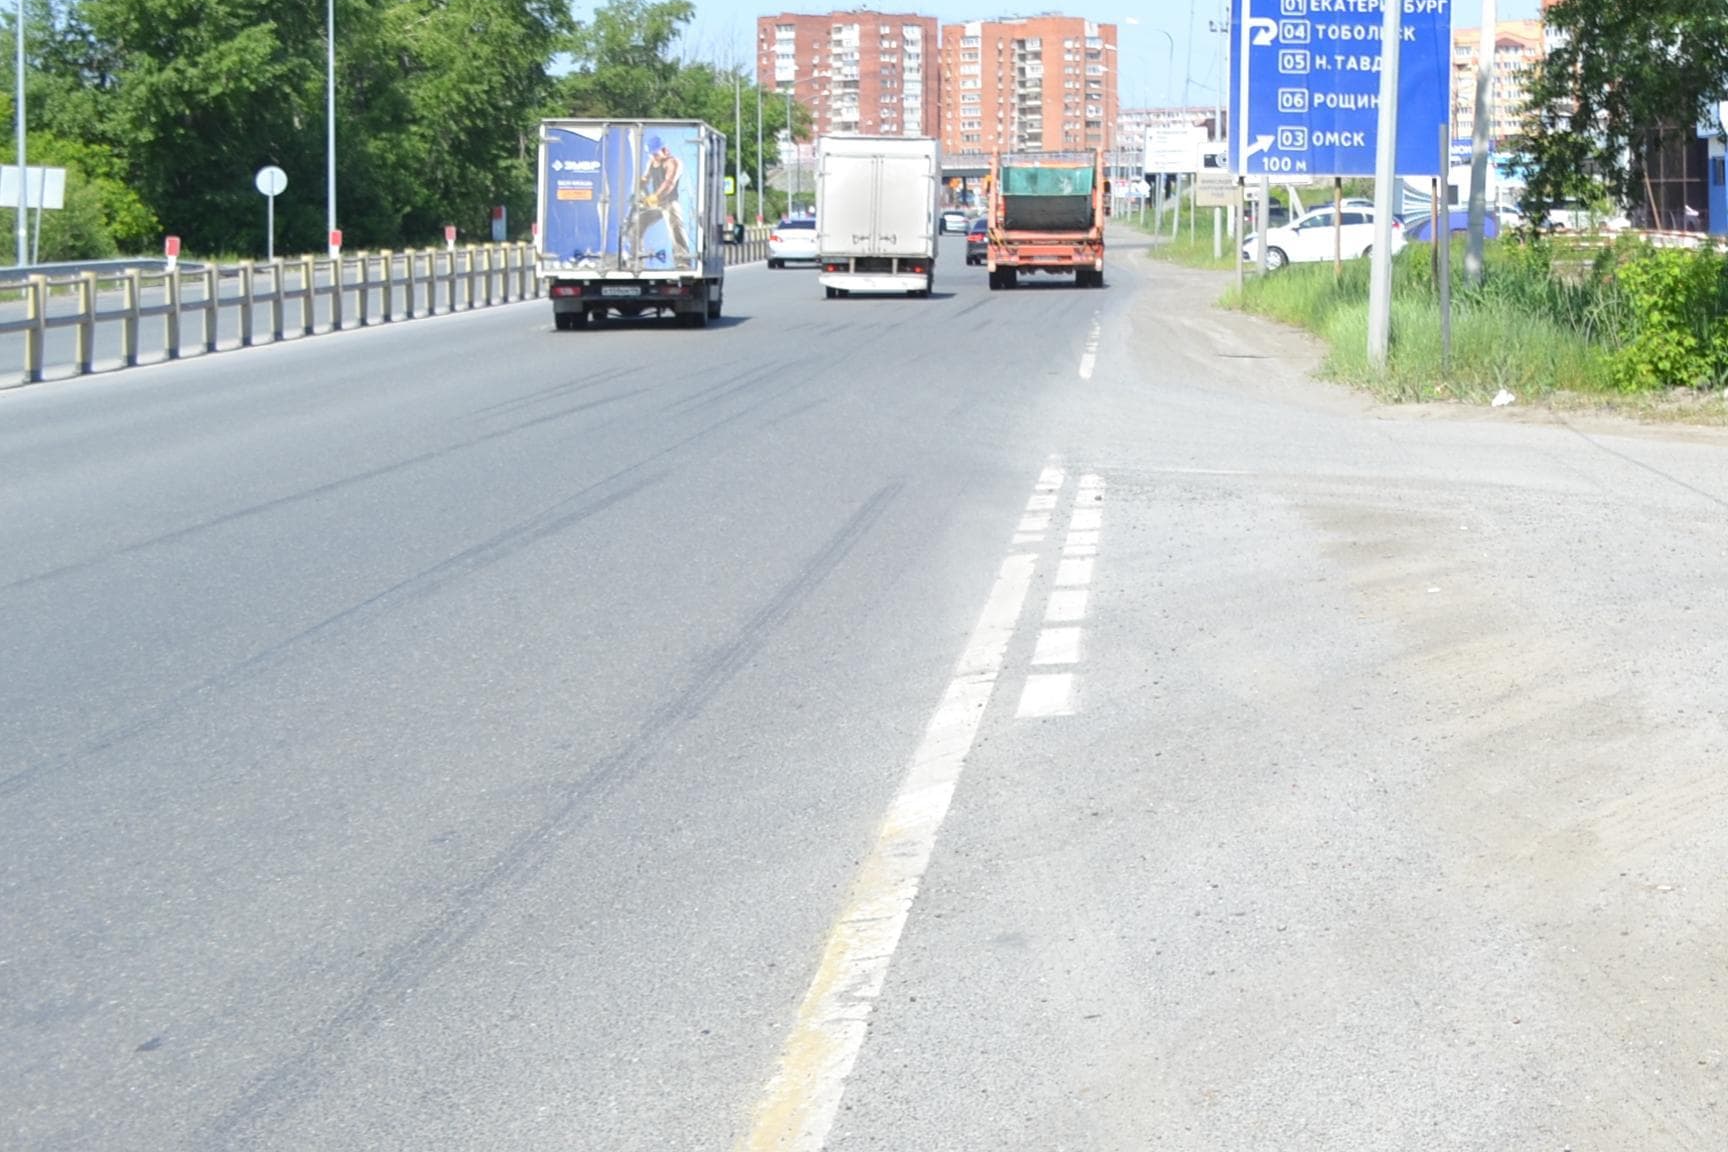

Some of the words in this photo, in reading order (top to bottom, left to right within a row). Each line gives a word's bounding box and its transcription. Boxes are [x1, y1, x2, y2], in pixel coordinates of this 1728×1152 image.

[1284, 25, 1306, 39] 04
[1316, 24, 1416, 41] ТОБОЛК
[1284, 55, 1304, 69] 05
[1282, 93, 1303, 107] 06
[1314, 93, 1381, 111] РОЩИН
[1282, 132, 1303, 146] 03
[1312, 131, 1365, 147] ОМСК
[1262, 157, 1291, 171] 100
